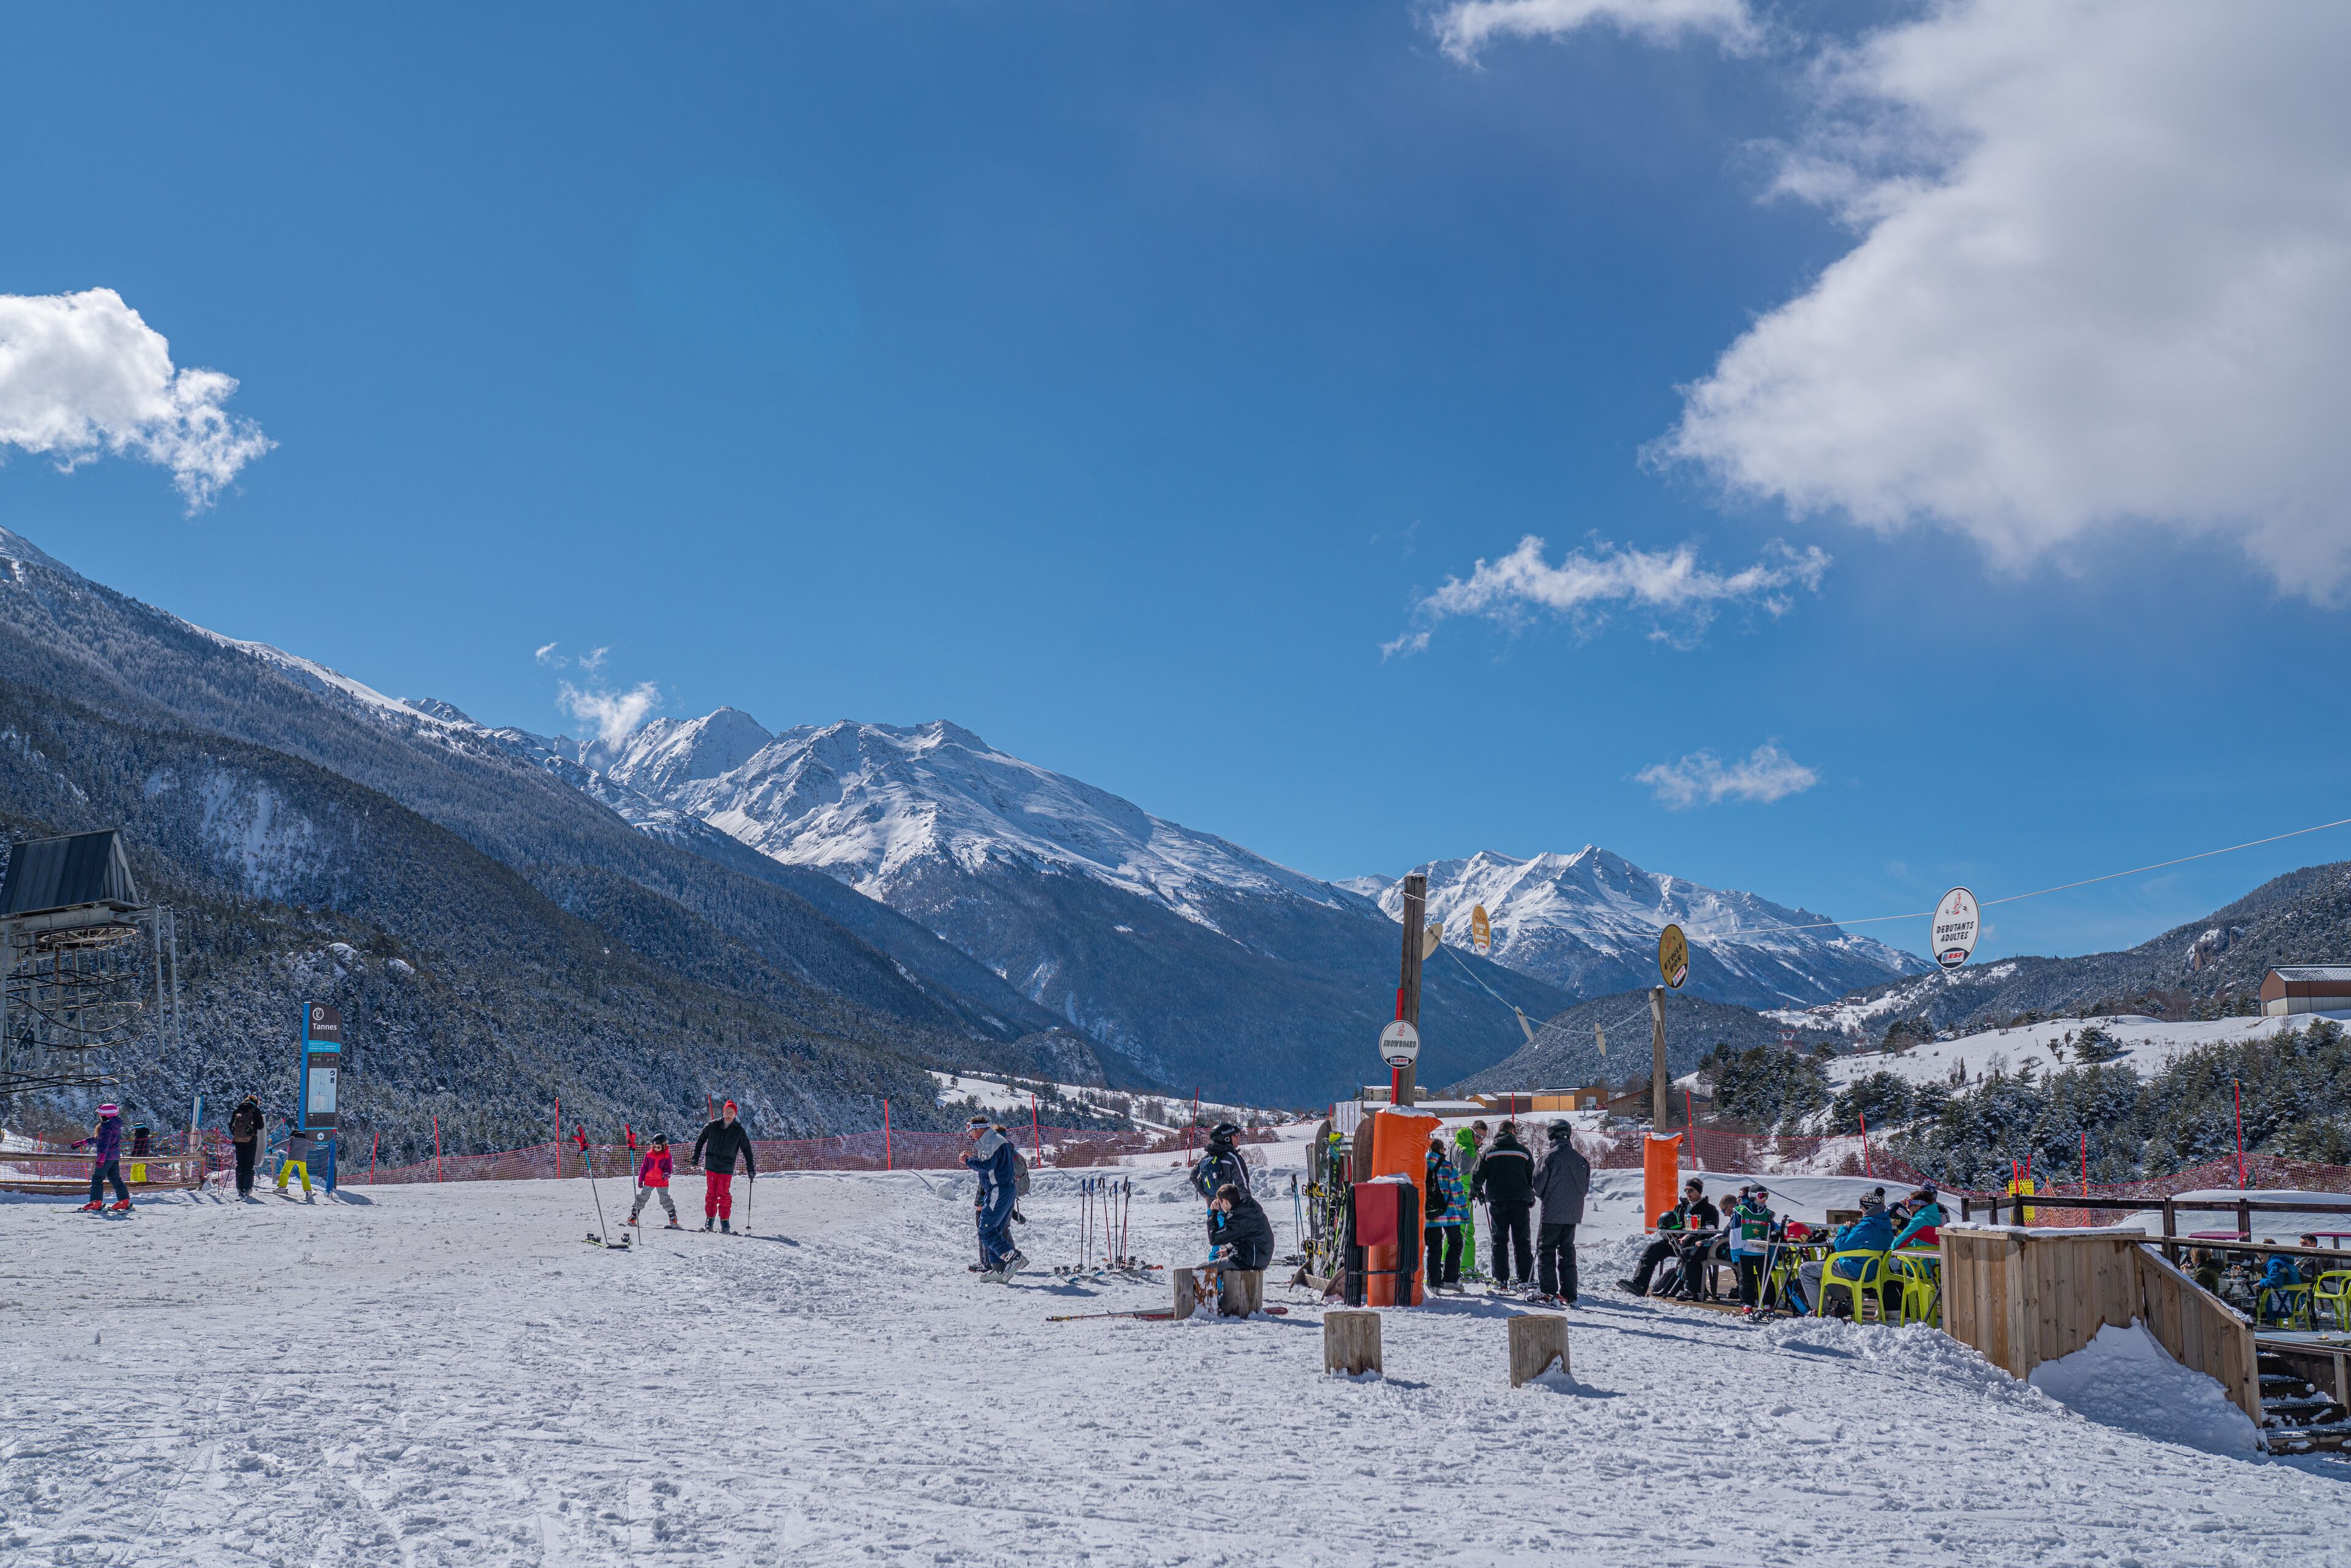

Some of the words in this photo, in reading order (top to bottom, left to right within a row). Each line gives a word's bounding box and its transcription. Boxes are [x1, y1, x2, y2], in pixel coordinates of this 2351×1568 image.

[1937, 921, 1974, 934] DEBUTANTS
[1940, 931, 1968, 942] ADULTES
[1664, 942, 1682, 970] ETOILE
[1383, 1040, 1417, 1048] SNOWBOARD
